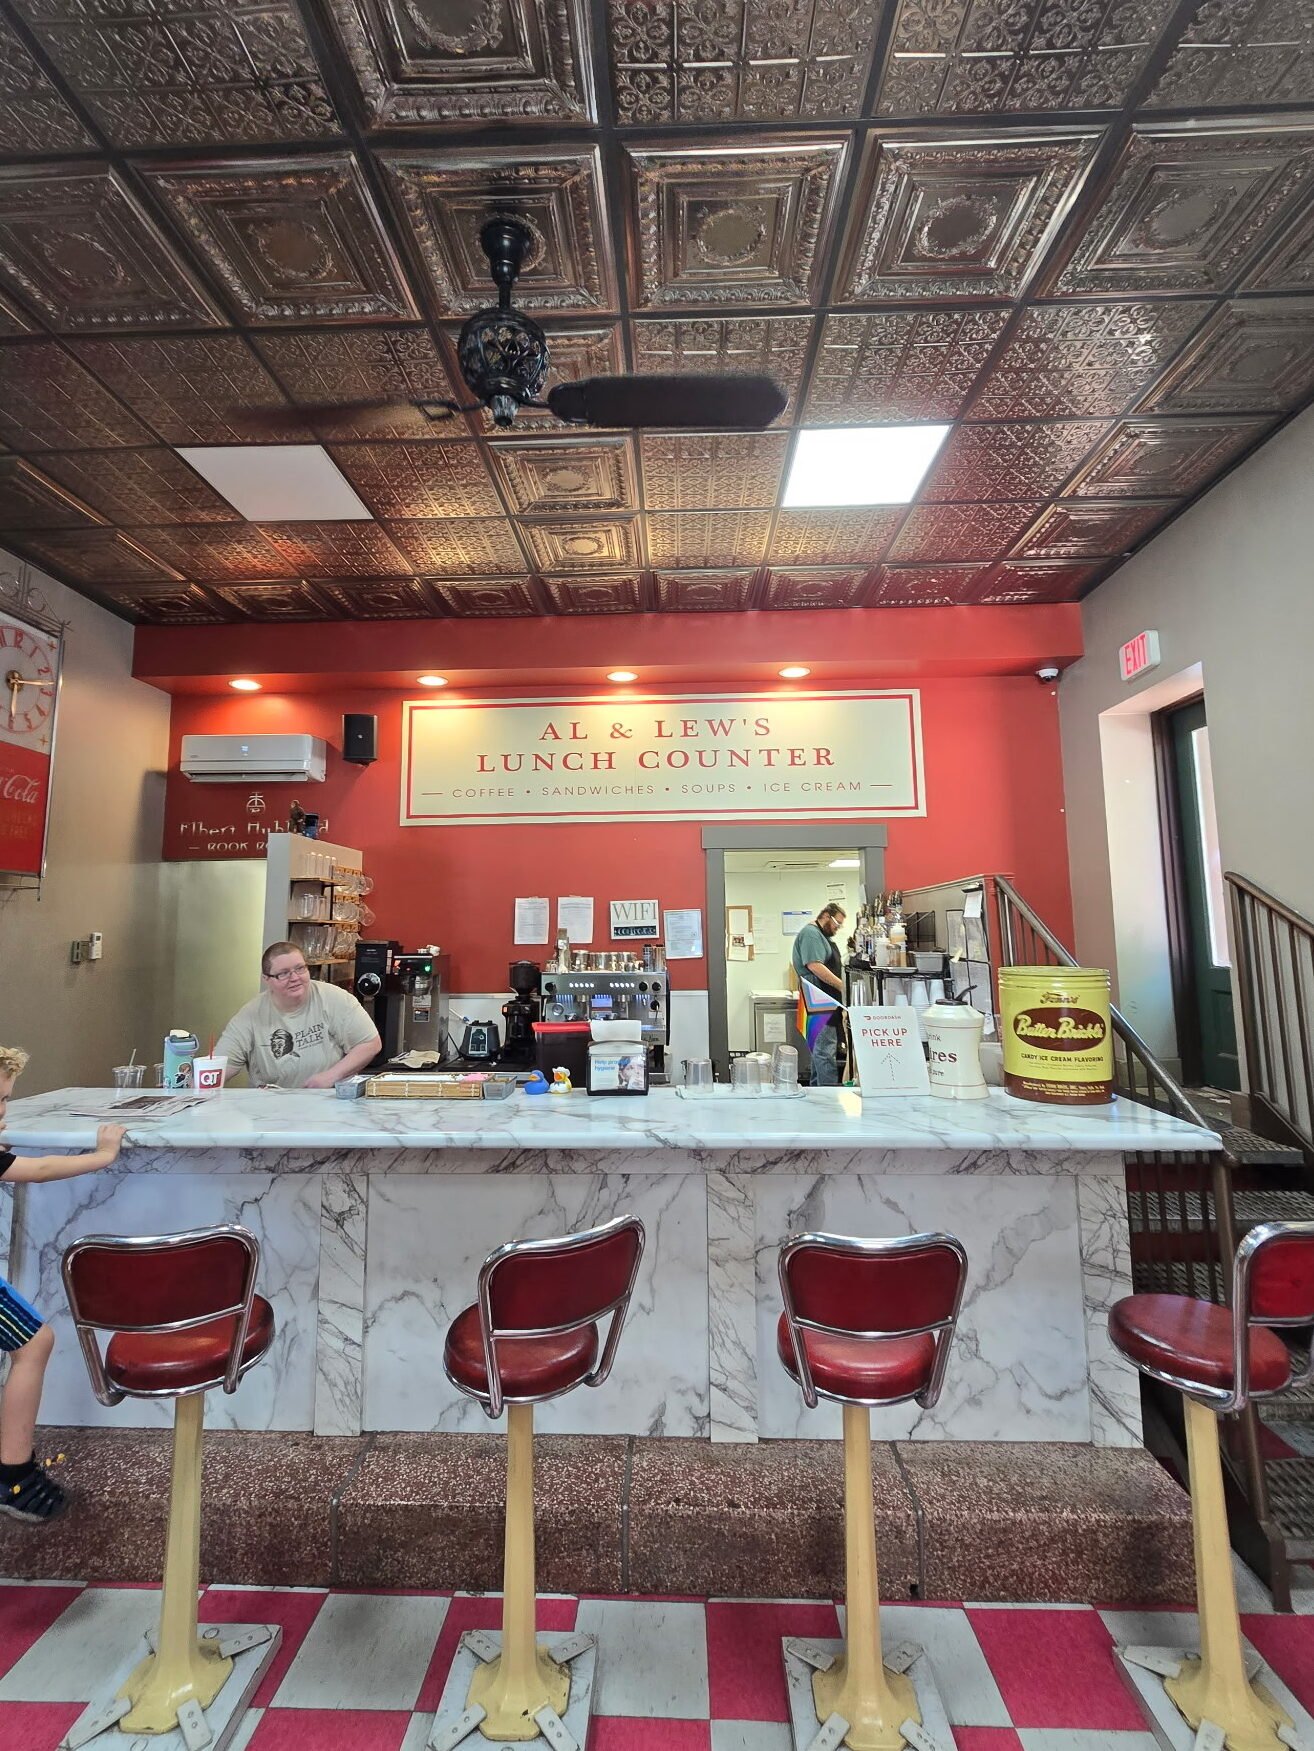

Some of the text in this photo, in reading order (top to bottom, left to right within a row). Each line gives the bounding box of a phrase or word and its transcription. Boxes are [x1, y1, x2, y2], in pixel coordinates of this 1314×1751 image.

[1124, 633, 1147, 675] EXIT
[538, 717, 771, 741] AL & LEW'S
[476, 747, 836, 773] LUNCH COUNTER
[452, 781, 863, 799] COFFEE SANDWICHES SOUPS ICE CREAM
[612, 902, 657, 921] WIFI
[294, 1022, 324, 1039] PLAIN
[862, 1028, 908, 1037] PICK UP
[1016, 1014, 1057, 1038] Butter
[295, 1032, 324, 1047] TALK
[871, 1038, 902, 1047] HERE
[928, 1047, 957, 1063] ires
[200, 1071, 220, 1086] QT
